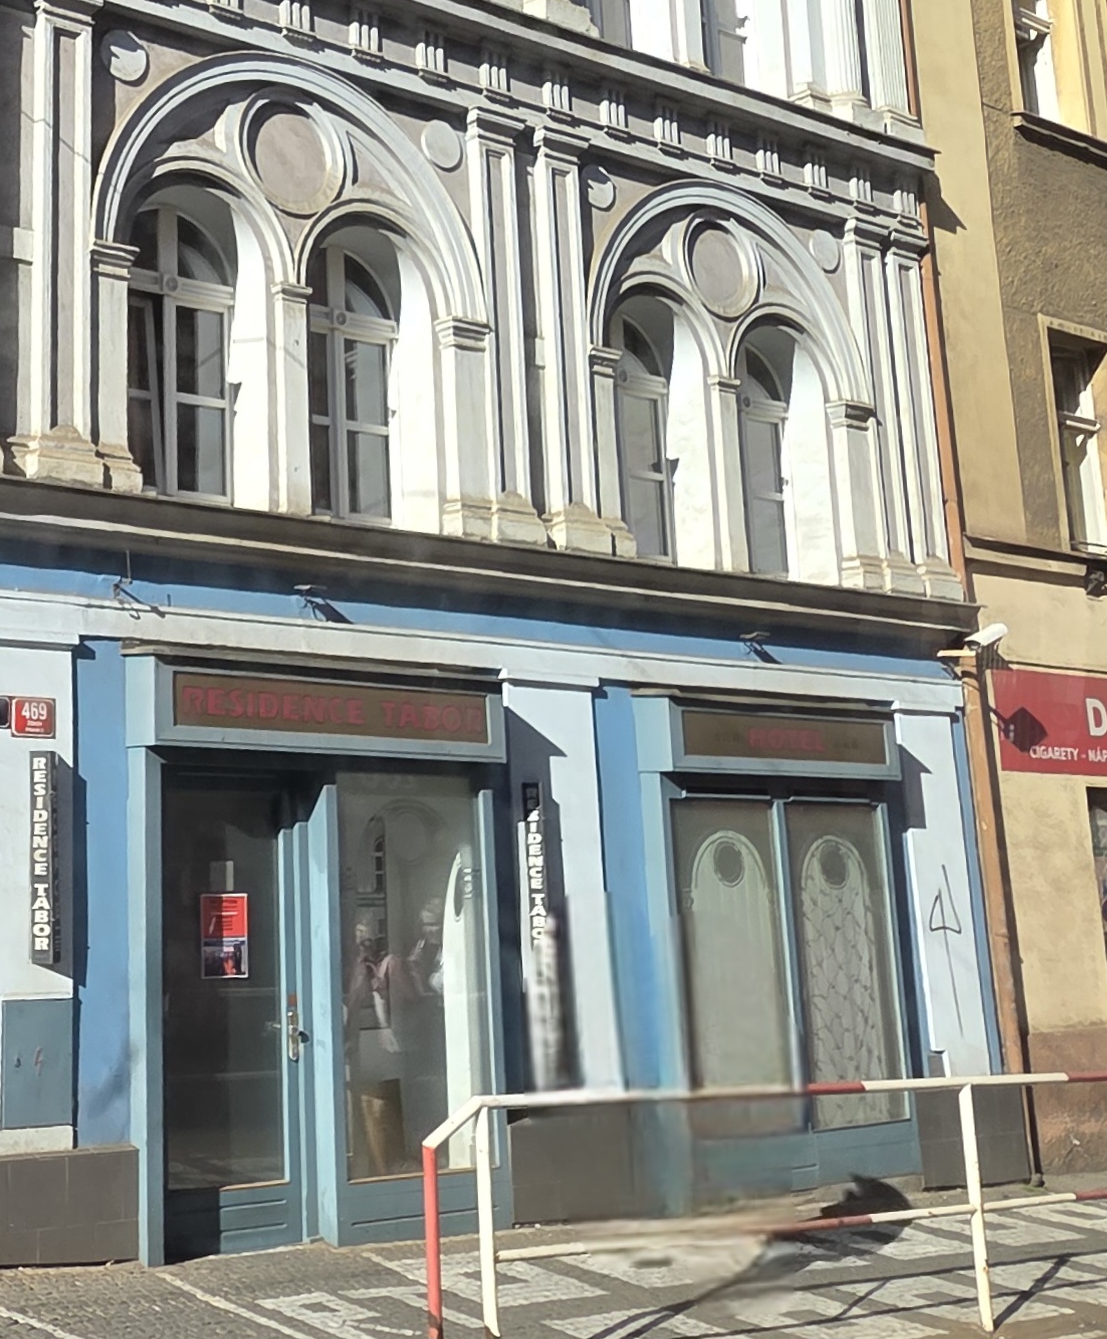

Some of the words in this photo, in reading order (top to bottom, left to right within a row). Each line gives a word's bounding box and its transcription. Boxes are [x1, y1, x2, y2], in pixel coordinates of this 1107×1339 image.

[21, 702, 48, 721] 469
[183, 685, 366, 726] RESIDENCE
[379, 700, 485, 734] TABOR
[748, 728, 827, 752] HOTEL
[1029, 745, 1079, 761] CIGARETY
[32, 757, 49, 876] RESIDENCE
[32, 883, 51, 951] TABOR
